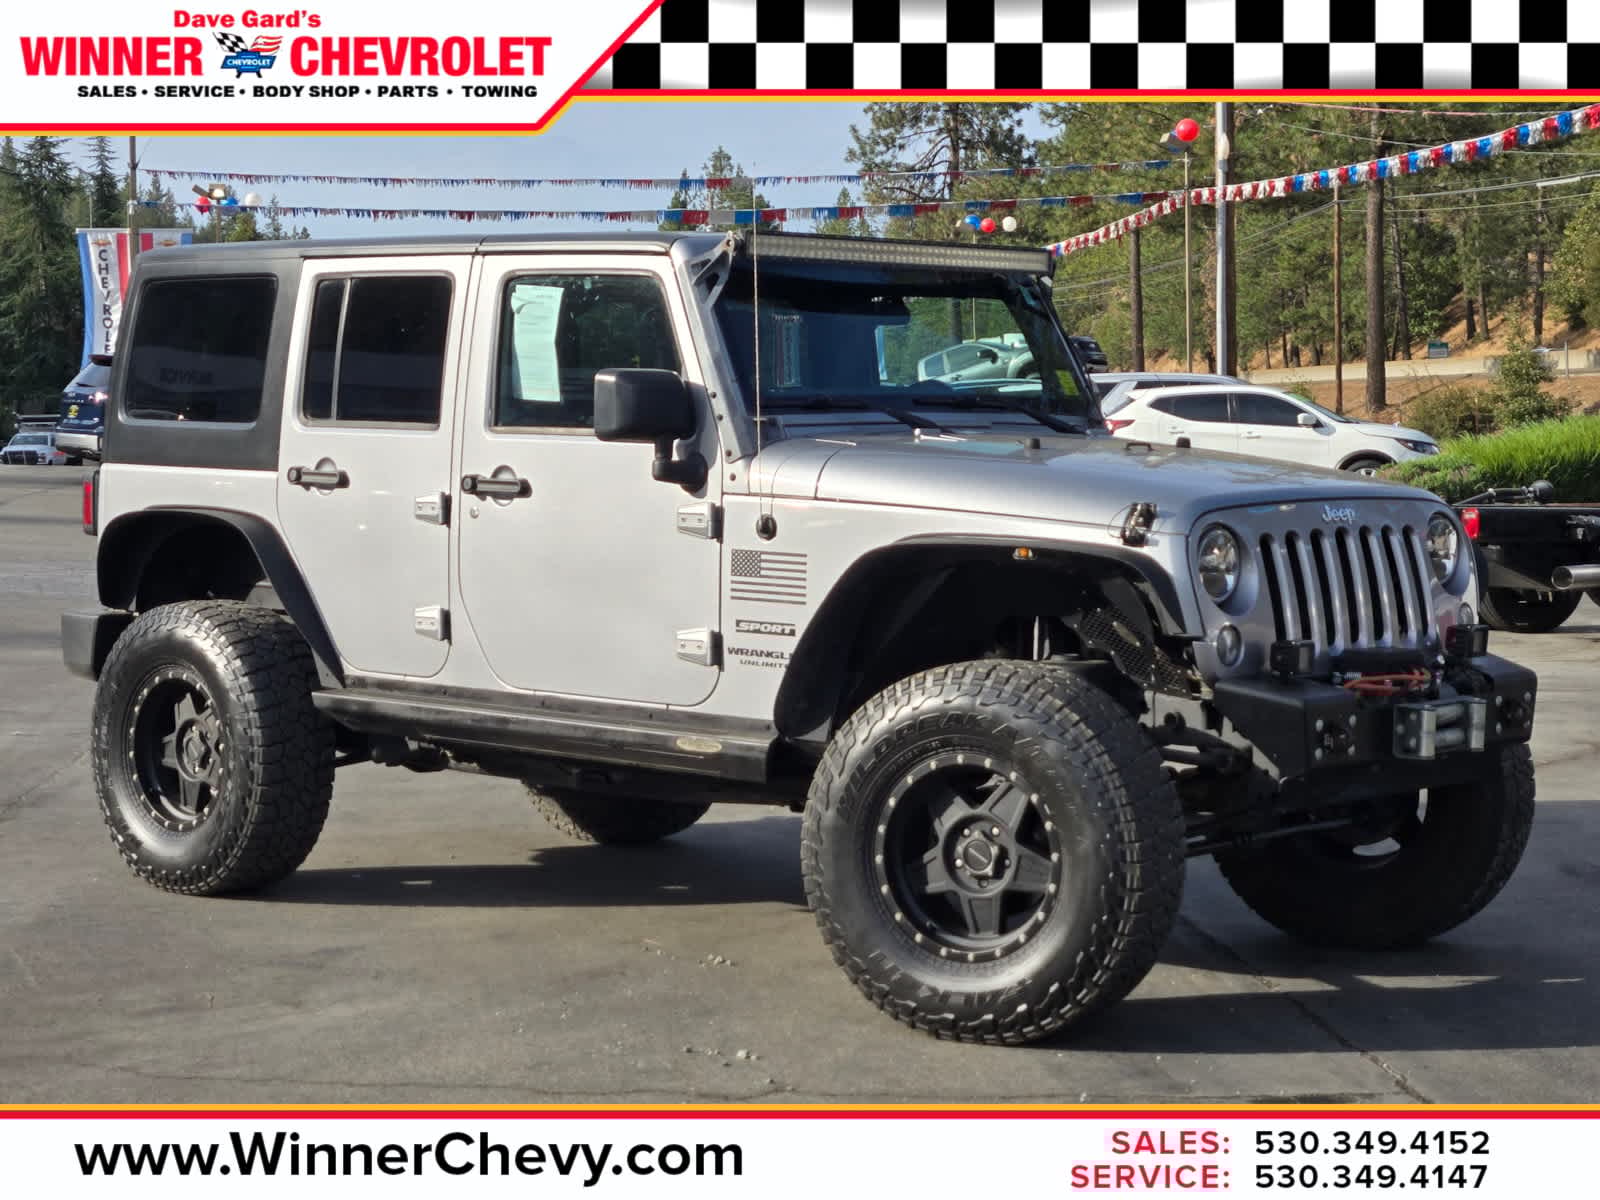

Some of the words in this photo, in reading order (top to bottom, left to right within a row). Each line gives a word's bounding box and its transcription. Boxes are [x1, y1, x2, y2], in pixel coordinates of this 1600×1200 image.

[98, 249, 114, 353] CHEVROLE
[1322, 504, 1356, 525] Jeep
[737, 620, 793, 635] SPORT
[727, 647, 792, 660] WRANGL
[739, 659, 788, 669] UNLIMIT
